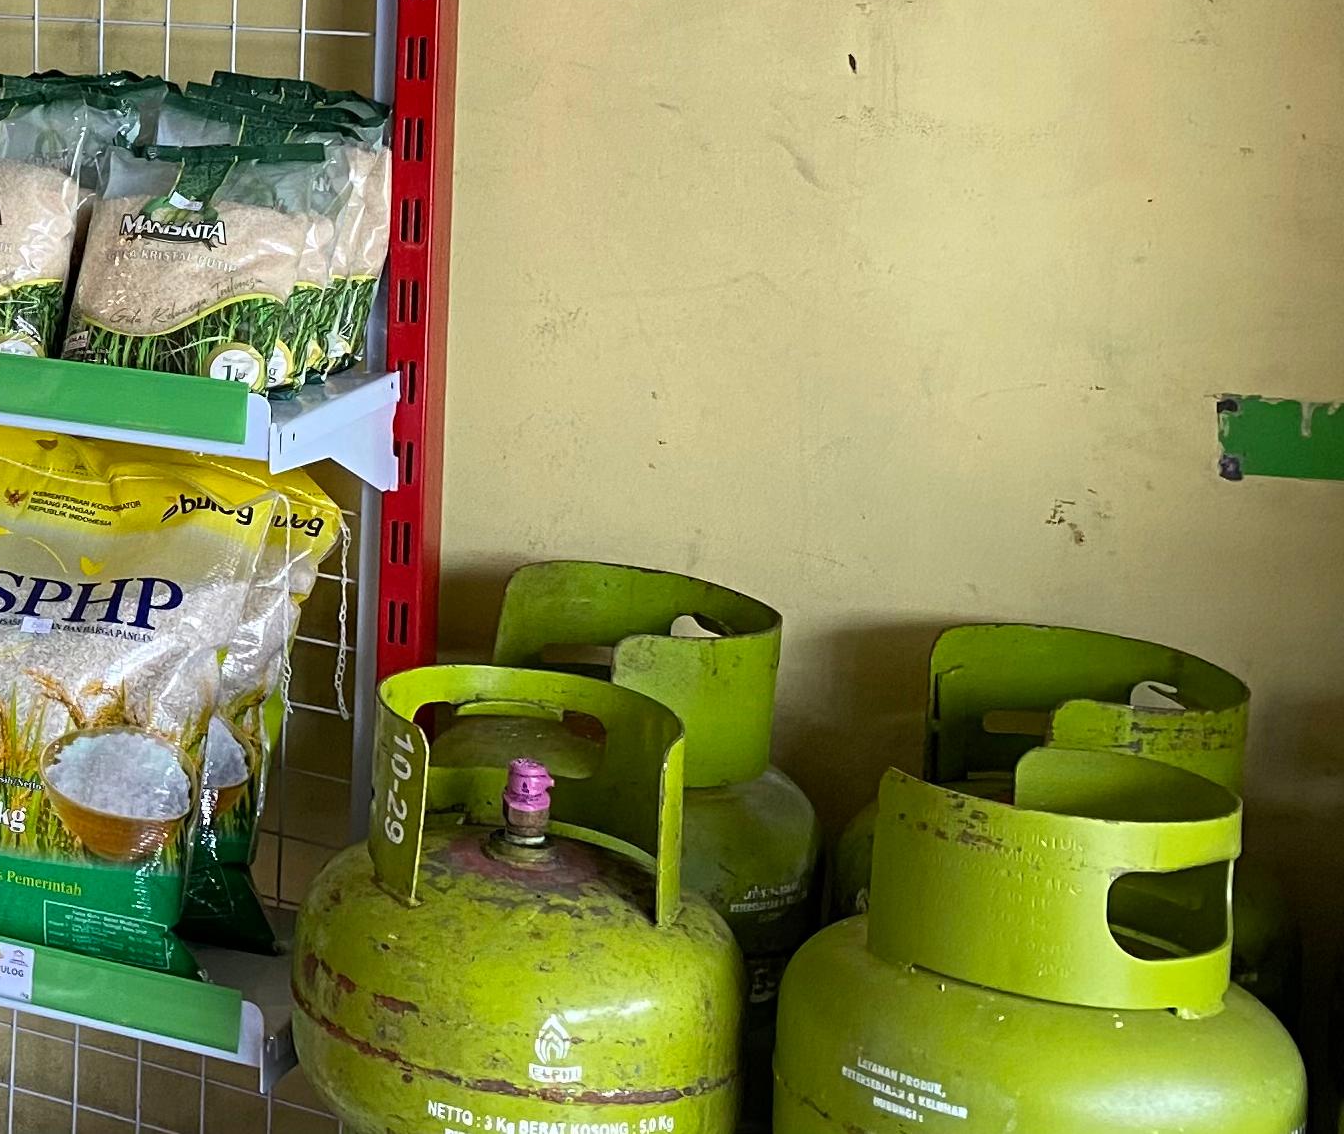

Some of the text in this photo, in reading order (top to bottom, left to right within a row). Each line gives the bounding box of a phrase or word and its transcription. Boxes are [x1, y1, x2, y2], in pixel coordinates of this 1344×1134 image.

[141, 249, 194, 263] KRISTAL
[32, 490, 90, 507] KEMENTERIAN
[61, 502, 96, 517] PANGAN
[385, 734, 415, 844] 10-29
[6, 870, 82, 897] Pemerintah
[427, 1100, 473, 1126] NETTO
[484, 1117, 493, 1132] 3
[496, 1117, 515, 1134] Kg
[518, 1120, 568, 1134] BERAT
[570, 1121, 629, 1134] KOSONG
[658, 1116, 675, 1133] Kg
